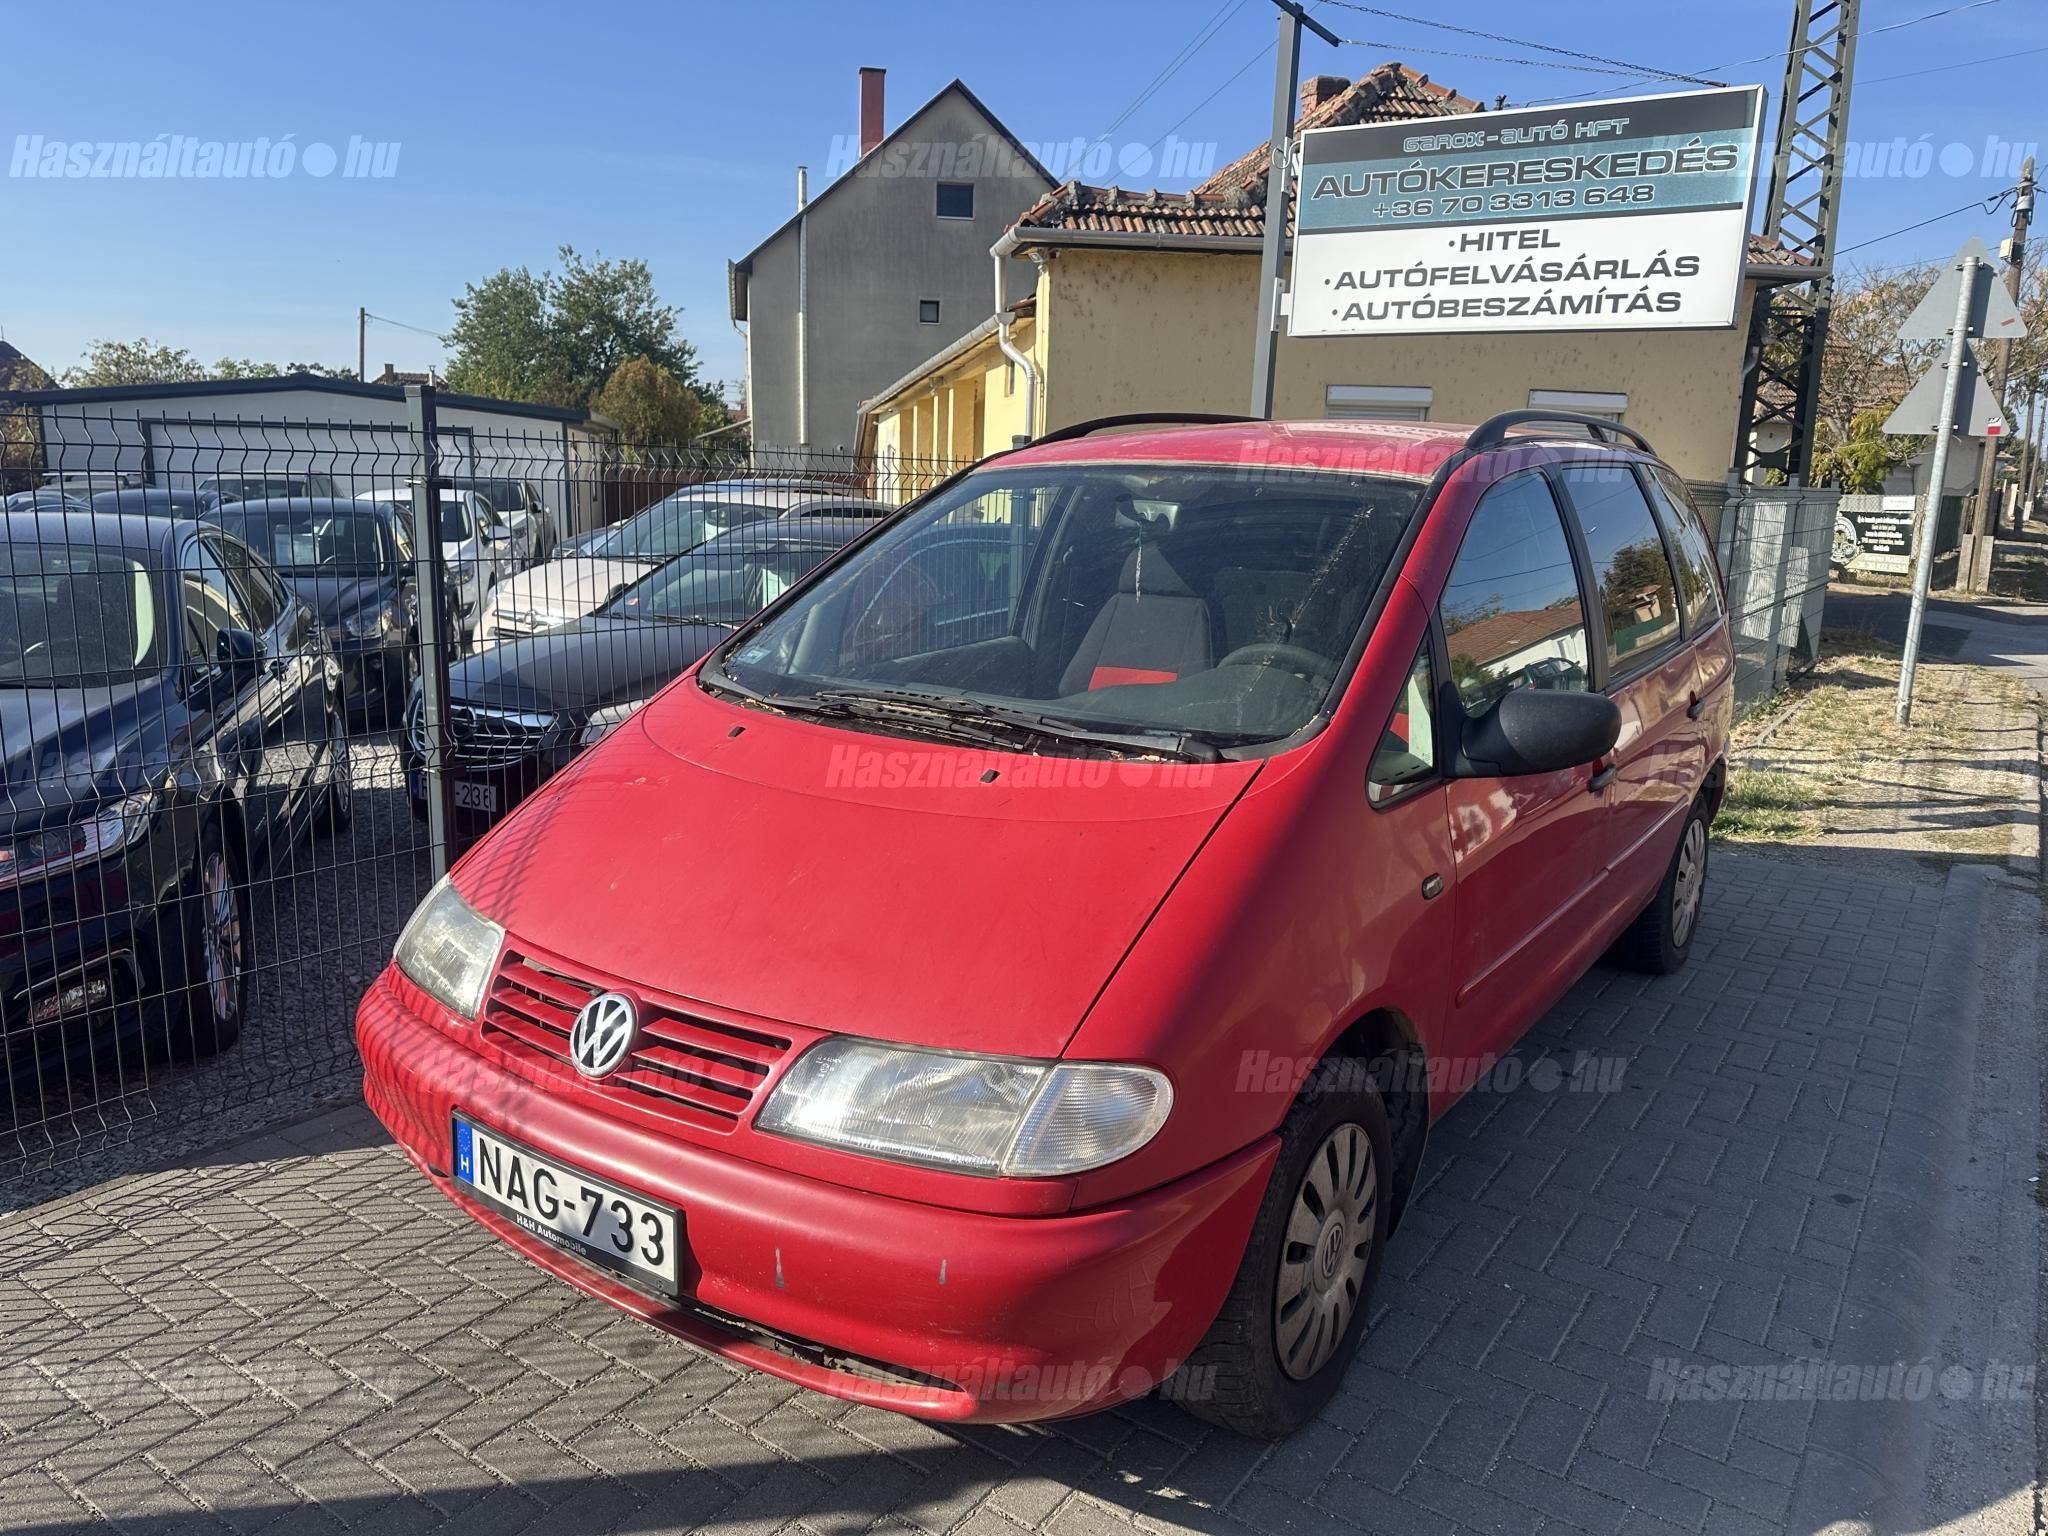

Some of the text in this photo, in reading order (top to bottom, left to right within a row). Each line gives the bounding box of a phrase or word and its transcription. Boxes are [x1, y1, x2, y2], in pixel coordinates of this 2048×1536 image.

[1312, 136, 1740, 200] AUTÓKERESKEDÉS
[1372, 183, 1657, 219] +36 70 3313 648
[479, 1137, 665, 1267] NAG-733
[537, 1224, 587, 1256] Automobile
